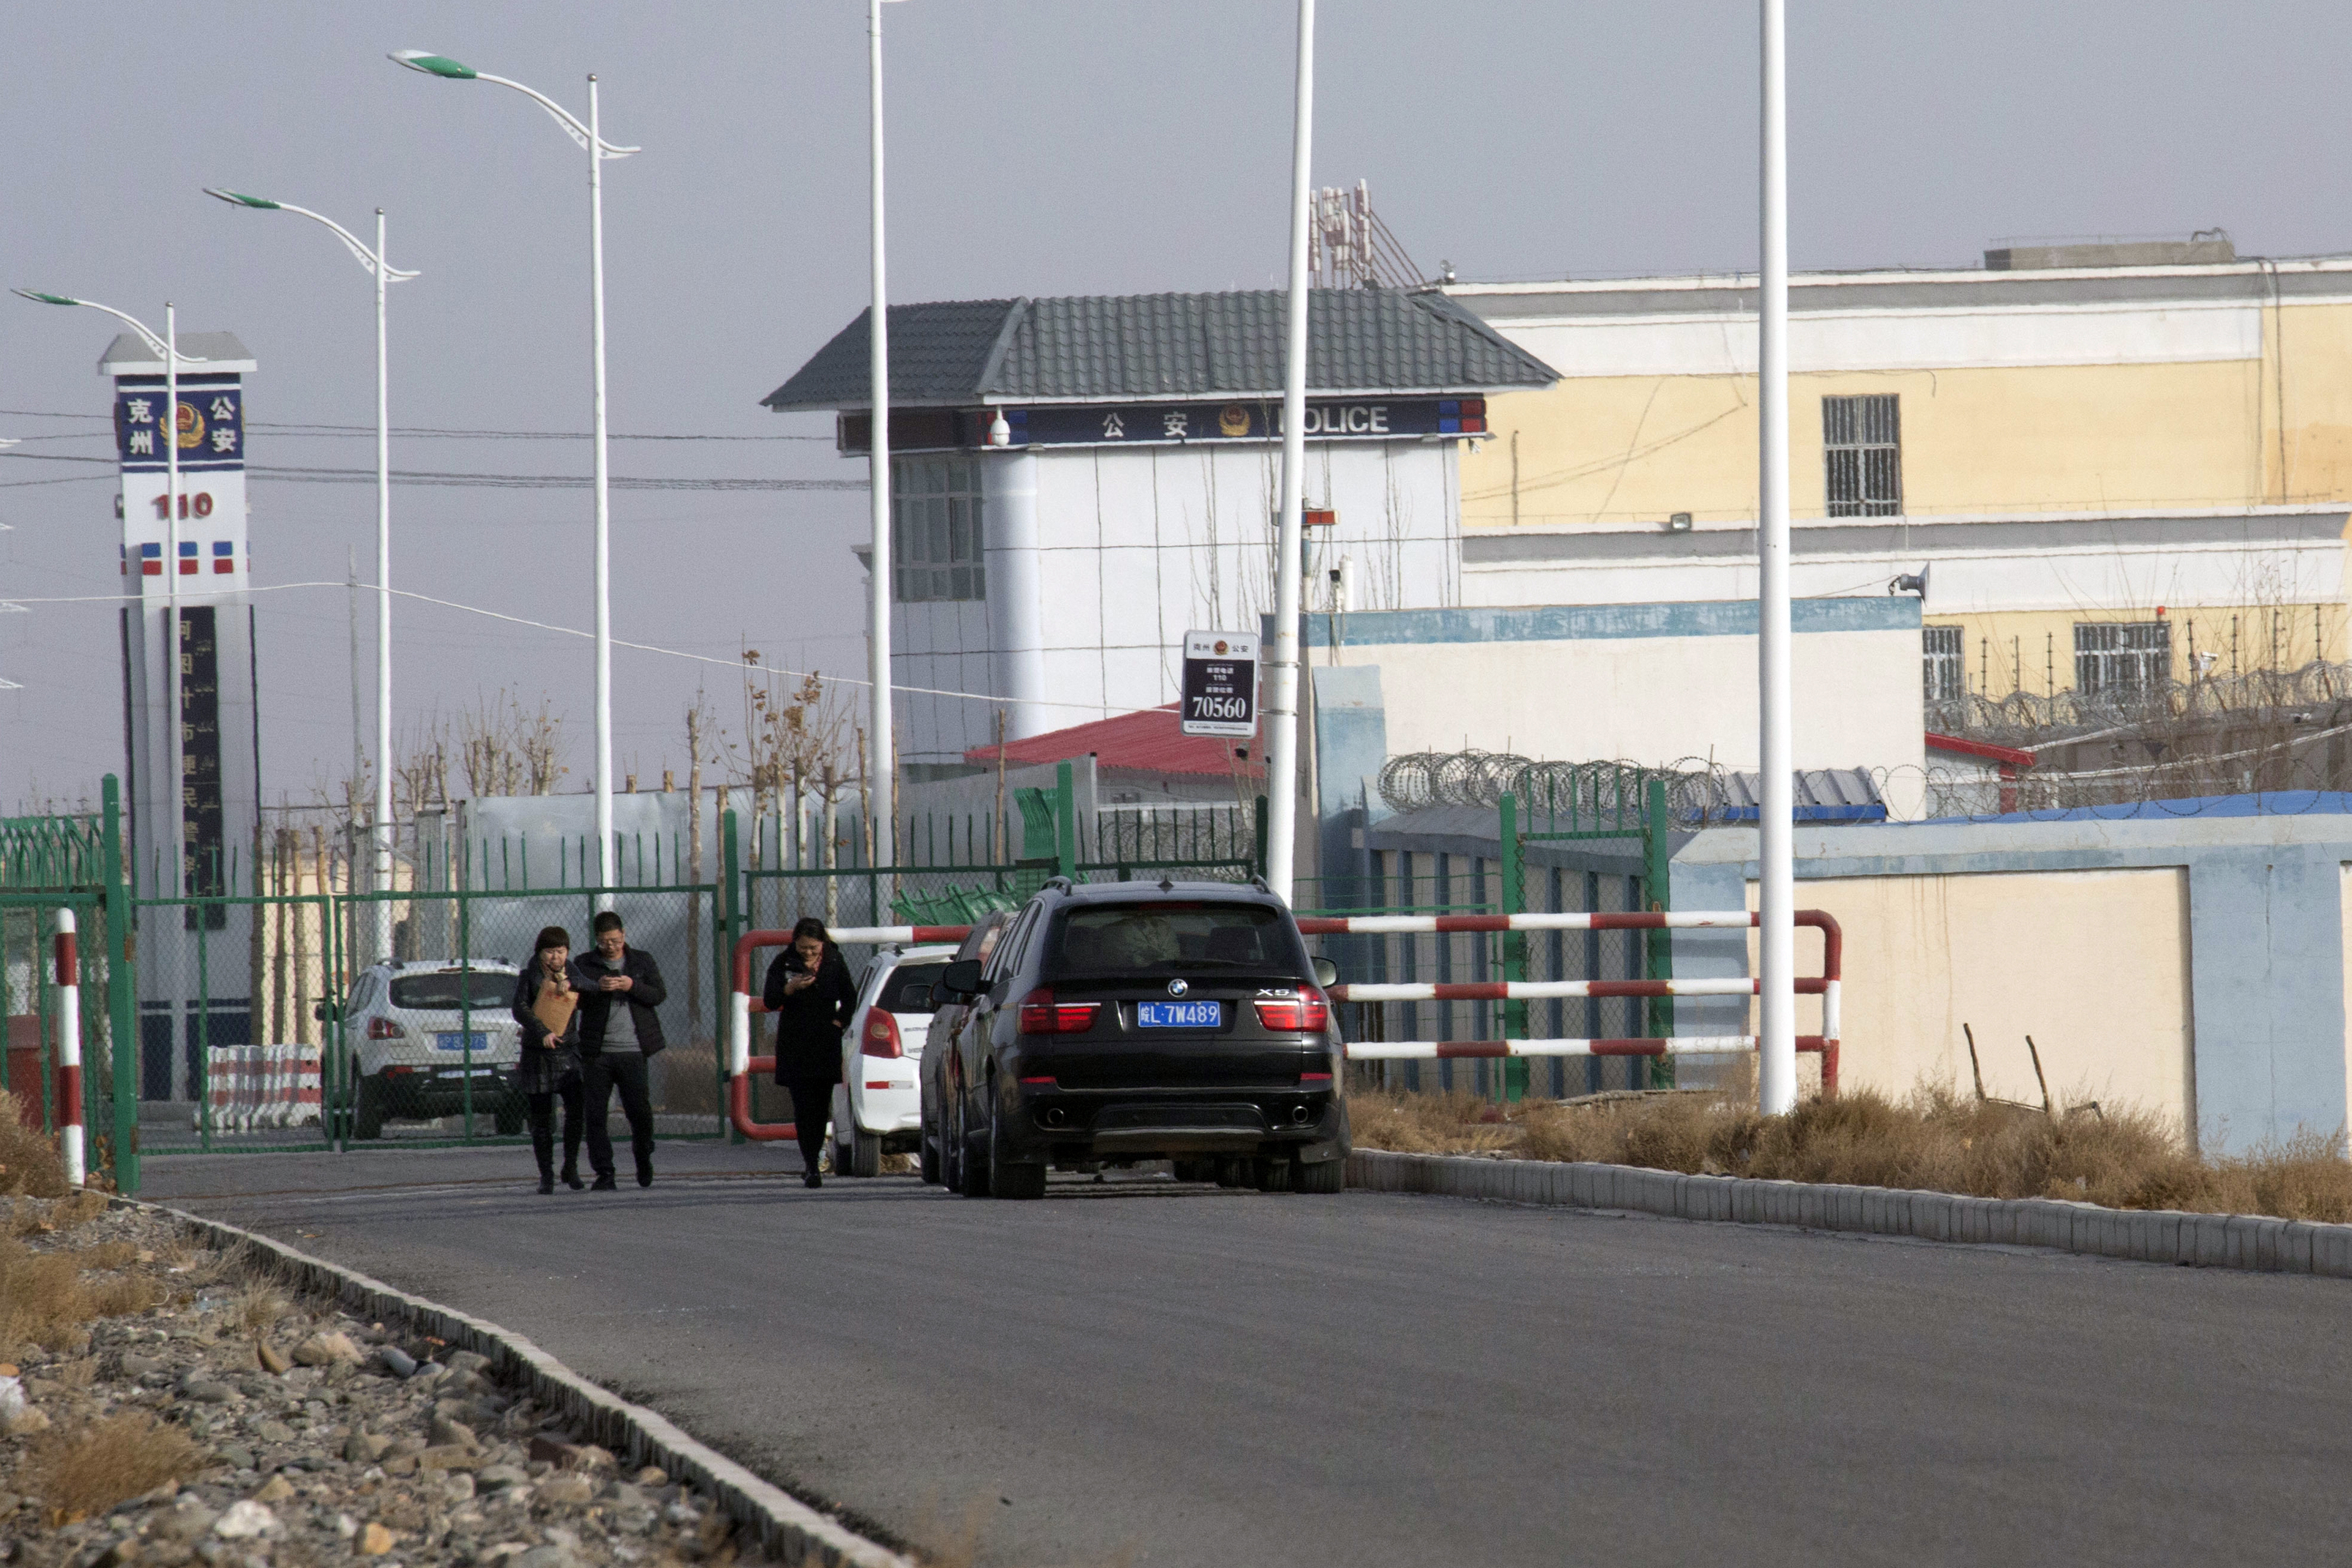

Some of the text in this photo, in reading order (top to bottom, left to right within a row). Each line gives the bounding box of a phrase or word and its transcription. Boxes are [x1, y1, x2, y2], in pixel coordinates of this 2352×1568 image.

[127, 398, 154, 455] 克州
[209, 396, 236, 453] 公安
[1102, 406, 1389, 437] 公安 OLICE
[154, 492, 213, 519] 110
[1192, 696, 1247, 719] 70560
[1255, 988, 1290, 996] X5
